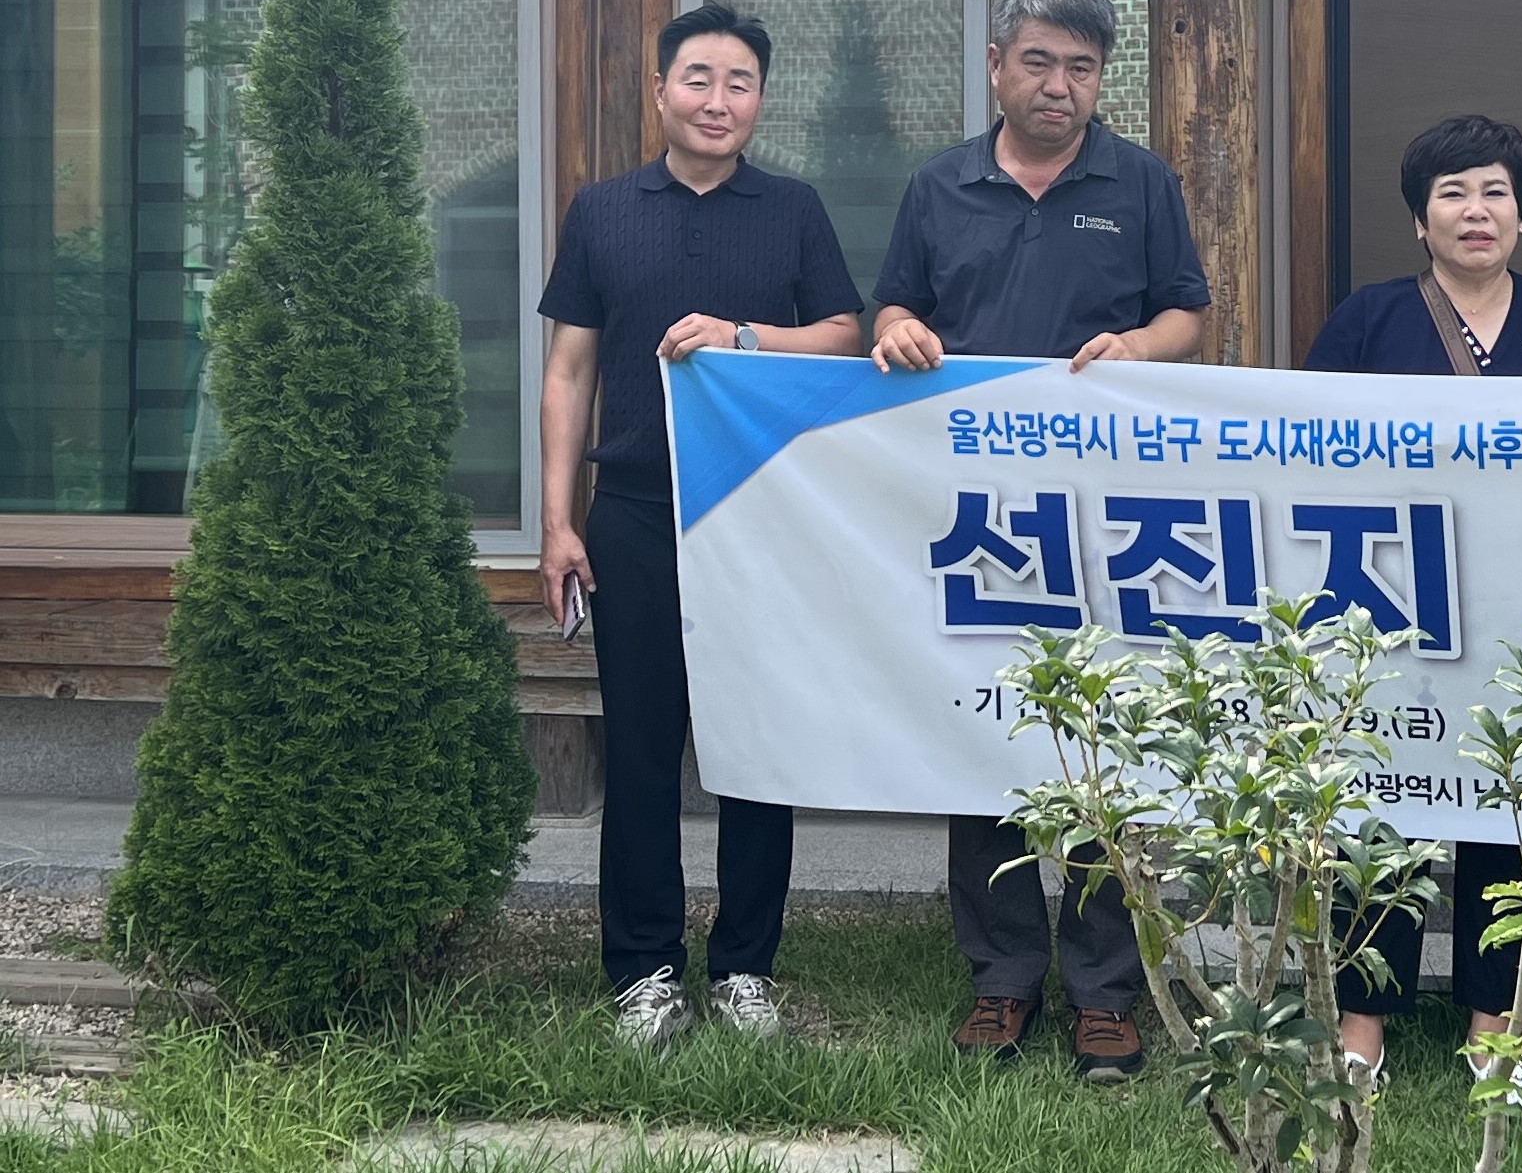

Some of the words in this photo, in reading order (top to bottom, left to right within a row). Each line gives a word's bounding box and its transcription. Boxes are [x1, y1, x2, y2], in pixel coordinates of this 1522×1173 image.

[947, 408, 1118, 461] 울산광역시
[1132, 414, 1202, 463] 남구
[1216, 416, 1435, 469] 도시재생사업
[928, 488, 1453, 653] 선진지
